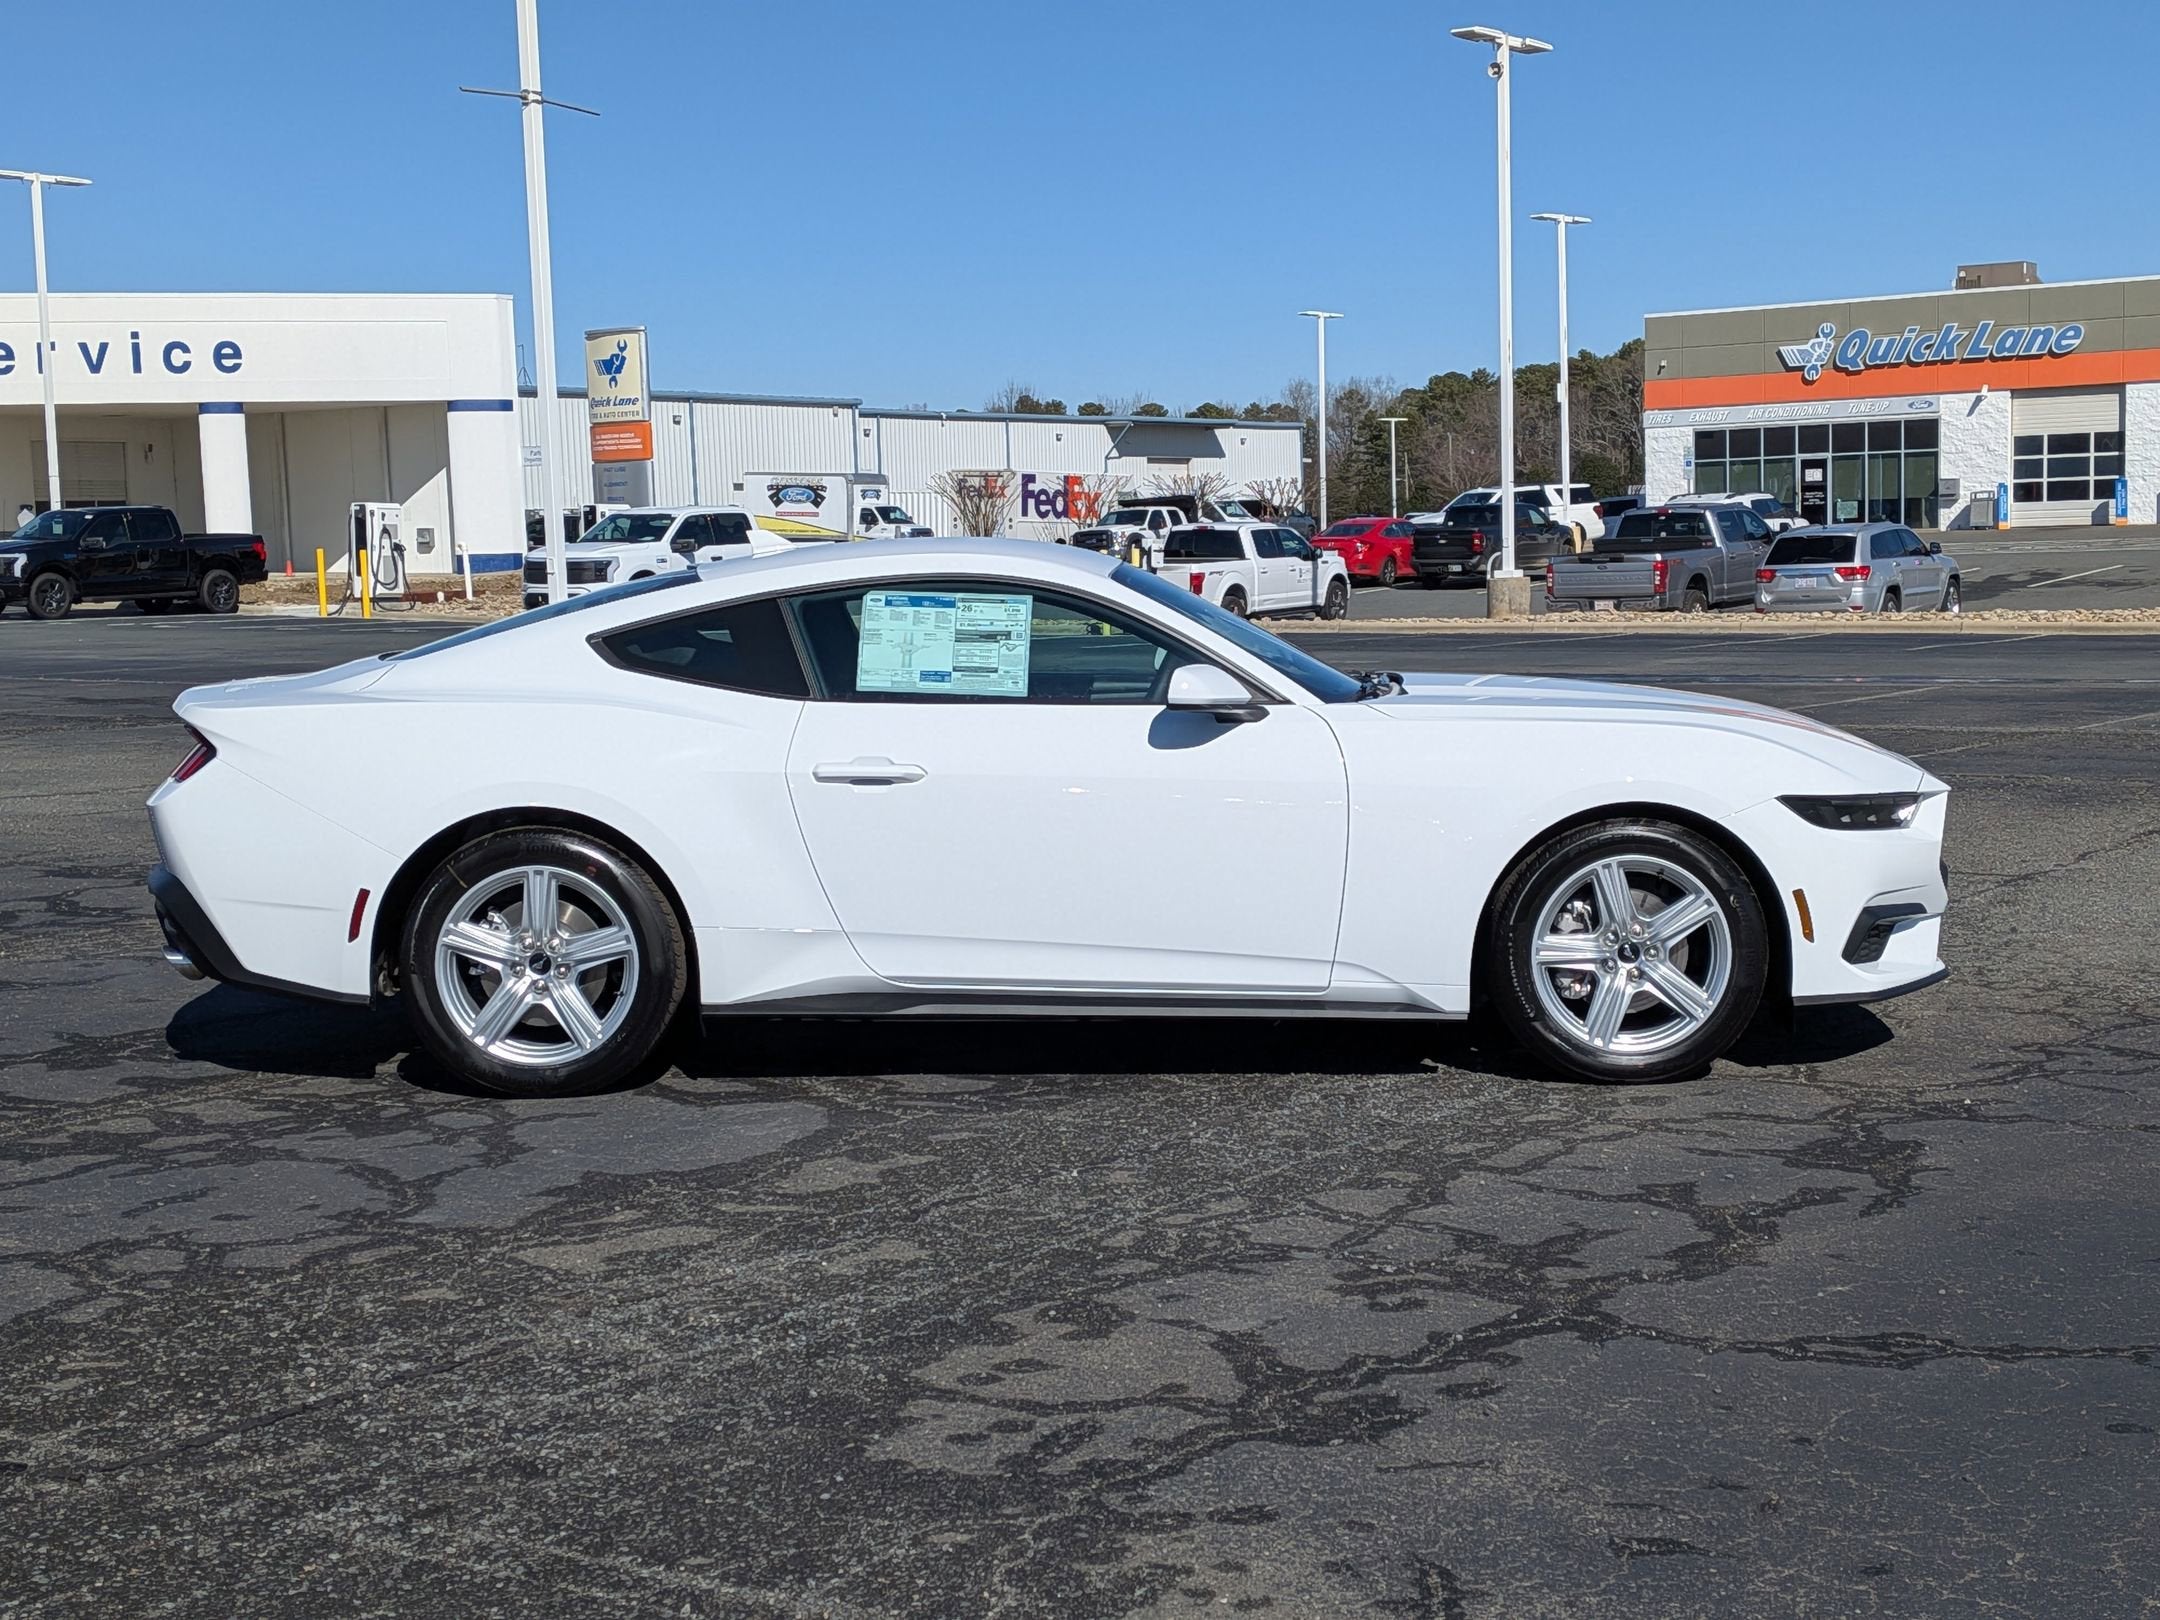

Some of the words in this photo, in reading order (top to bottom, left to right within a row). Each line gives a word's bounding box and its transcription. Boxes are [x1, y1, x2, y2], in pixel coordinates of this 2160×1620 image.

[1835, 323, 1967, 371] Quick
[1964, 321, 2085, 360] Lane
[612, 395, 640, 407] Lane
[1648, 413, 1673, 425] TIRES
[1689, 410, 1731, 423] EXHAUST
[1747, 408, 1765, 419] AIR
[1765, 404, 1830, 418] CONDITIONING
[1848, 402, 1890, 414] TUNE-UP
[786, 489, 809, 501] Ford
[1021, 473, 1103, 519] FedEx
[961, 604, 973, 613] 26
